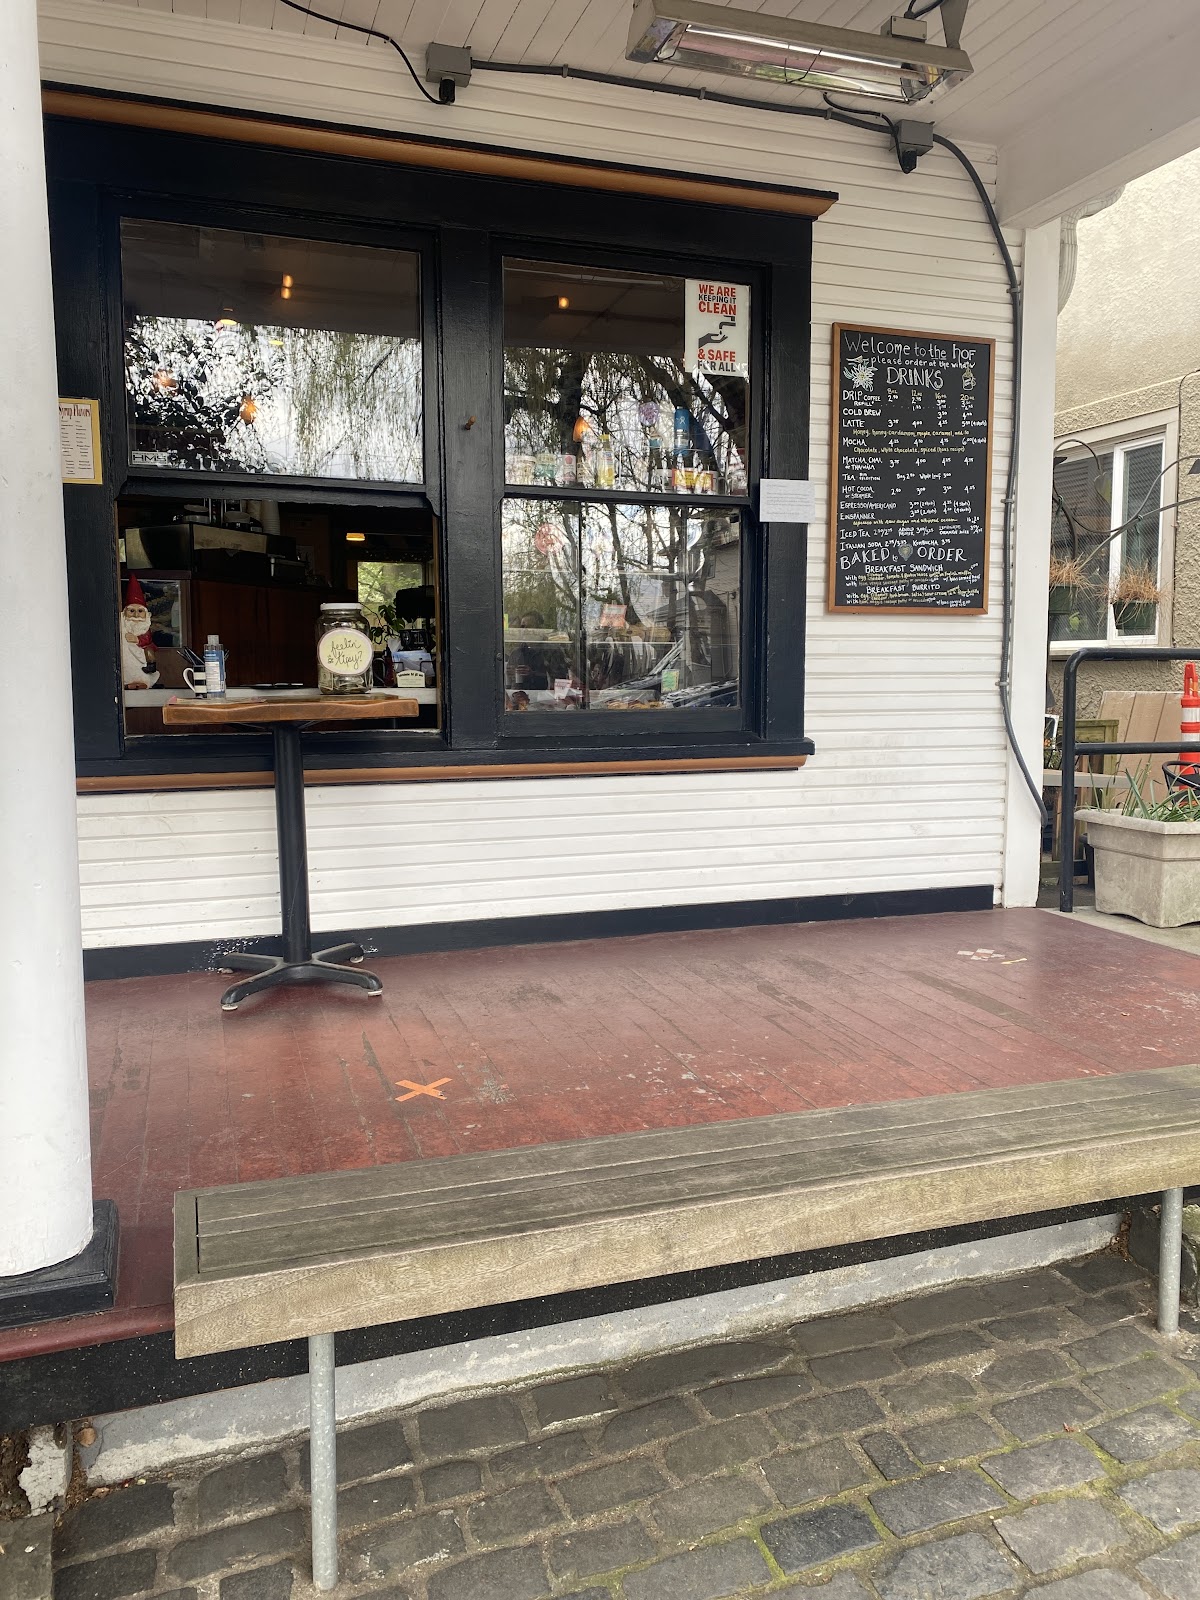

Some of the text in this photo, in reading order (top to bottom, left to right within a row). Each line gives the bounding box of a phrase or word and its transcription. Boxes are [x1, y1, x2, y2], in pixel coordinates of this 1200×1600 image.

[699, 284, 736, 297] WE ARE
[699, 294, 729, 303] KEEPING
[698, 301, 737, 316] CLEAN
[844, 332, 911, 357] Welcome
[914, 342, 926, 357] to
[928, 343, 946, 359] the
[698, 349, 736, 362] & SAFE
[697, 360, 736, 372] FOR ALL
[870, 356, 902, 368] please
[939, 361, 949, 370] the
[887, 366, 943, 391] DRINKS
[843, 390, 863, 400] DRIP
[843, 419, 865, 427] LATTE
[843, 437, 867, 447] MOCHA
[842, 473, 856, 481] TEA
[842, 485, 856, 494] HOT
[840, 529, 857, 539] ICED
[858, 529, 871, 537] TEA
[840, 542, 865, 552] ITALIAN
[840, 547, 890, 570] BAKED
[917, 547, 967, 562] ORDER
[865, 564, 943, 574] BREAKFAST SANDWICH
[866, 585, 906, 595] BREAKFAST
